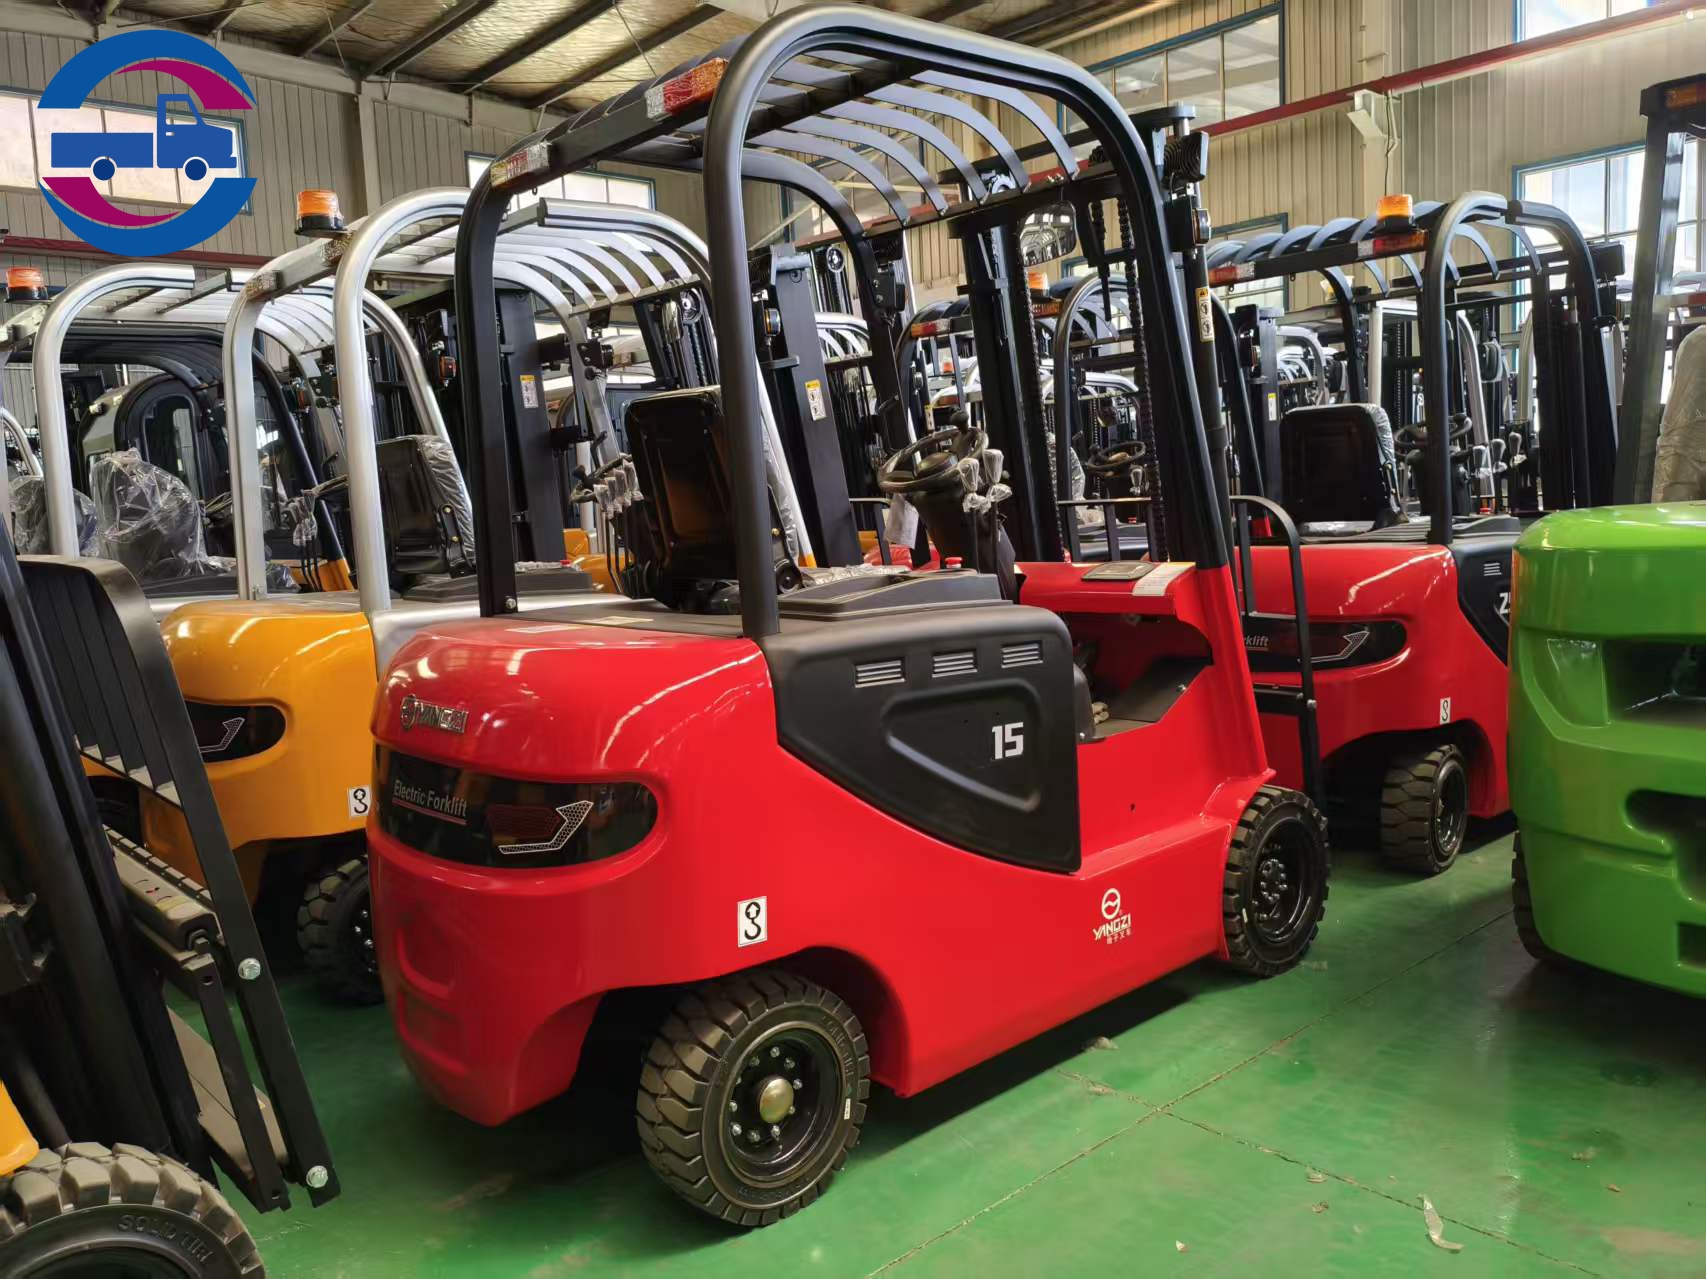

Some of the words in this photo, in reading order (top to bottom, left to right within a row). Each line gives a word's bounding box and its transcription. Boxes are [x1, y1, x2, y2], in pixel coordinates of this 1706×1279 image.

[1244, 634, 1269, 647] klift
[991, 721, 1024, 760] 15
[394, 779, 426, 805] Electric
[427, 790, 467, 817] Forklift
[1092, 912, 1131, 941] YANGZI
